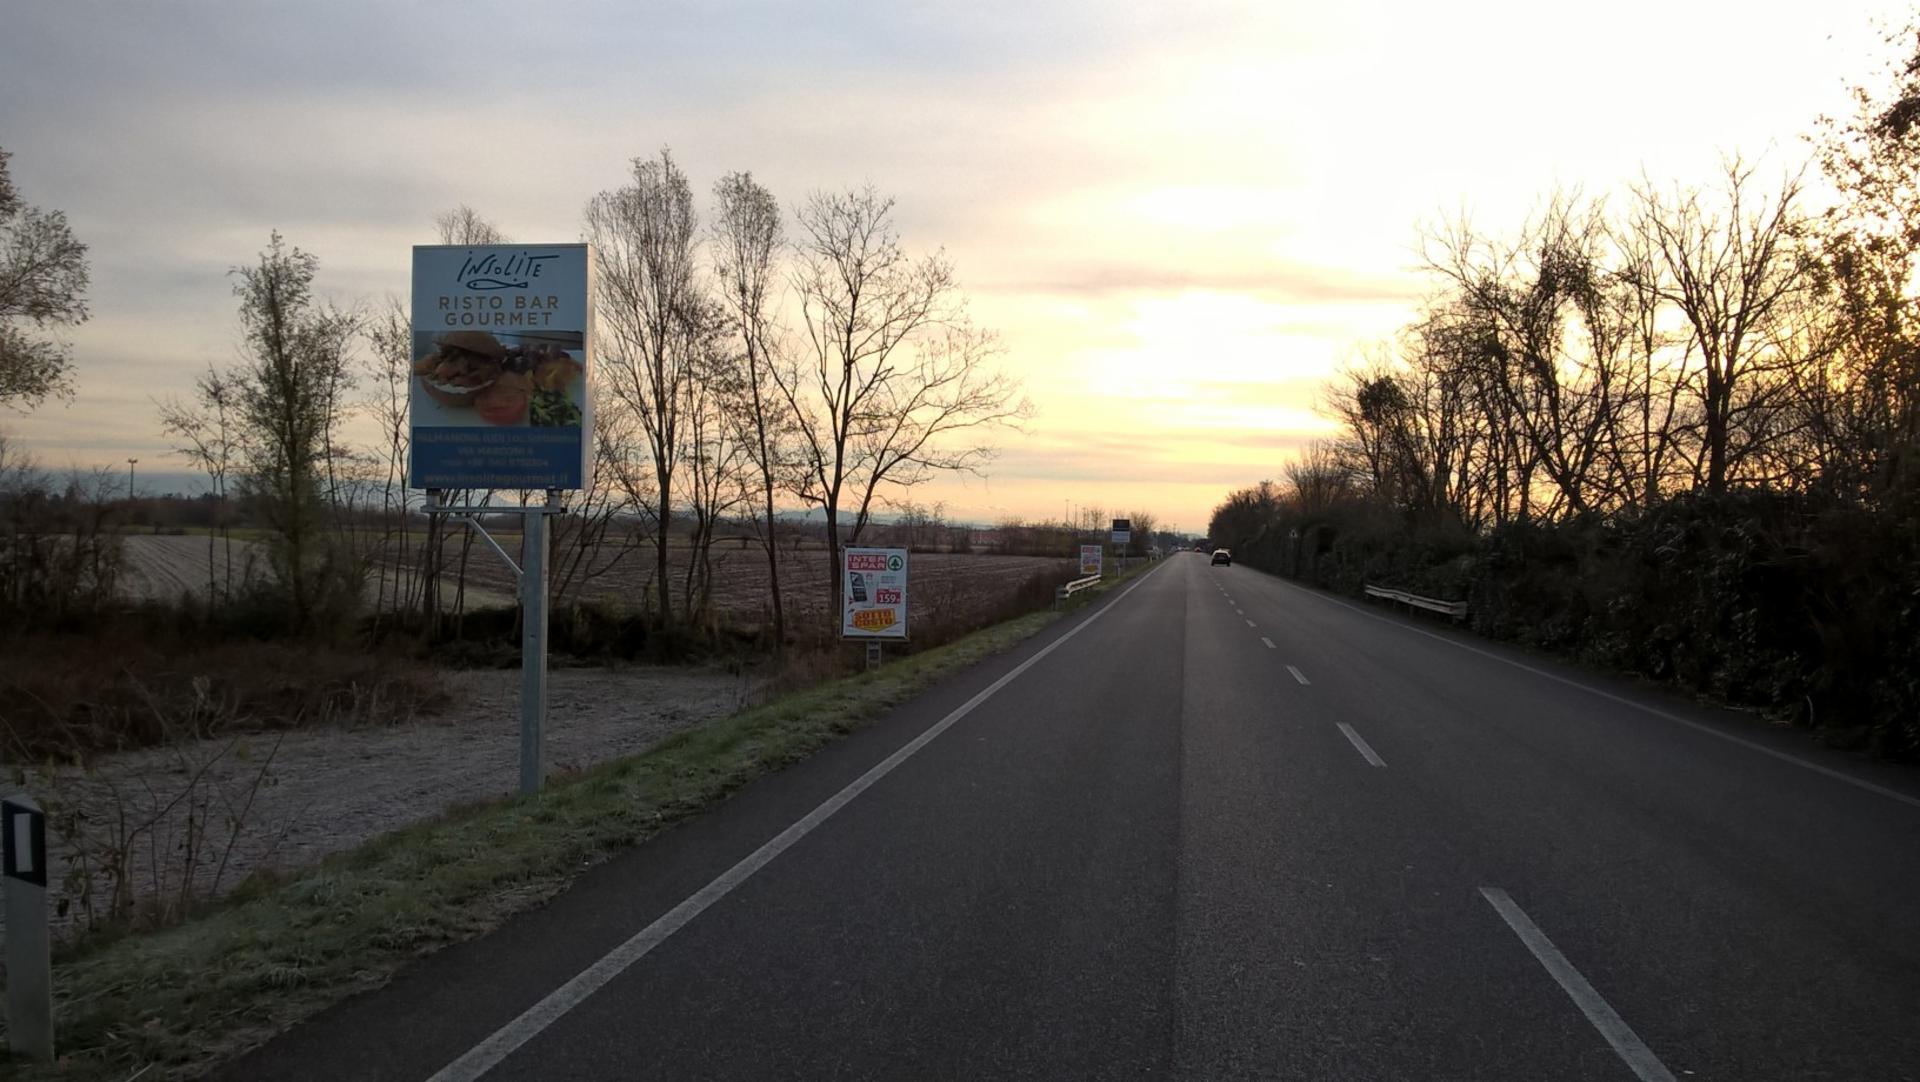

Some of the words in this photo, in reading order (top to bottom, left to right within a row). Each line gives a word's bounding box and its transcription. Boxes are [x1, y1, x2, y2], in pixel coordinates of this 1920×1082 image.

[439, 296, 503, 310] RISTO
[515, 295, 560, 309] BAR
[445, 312, 553, 326] GOURMET
